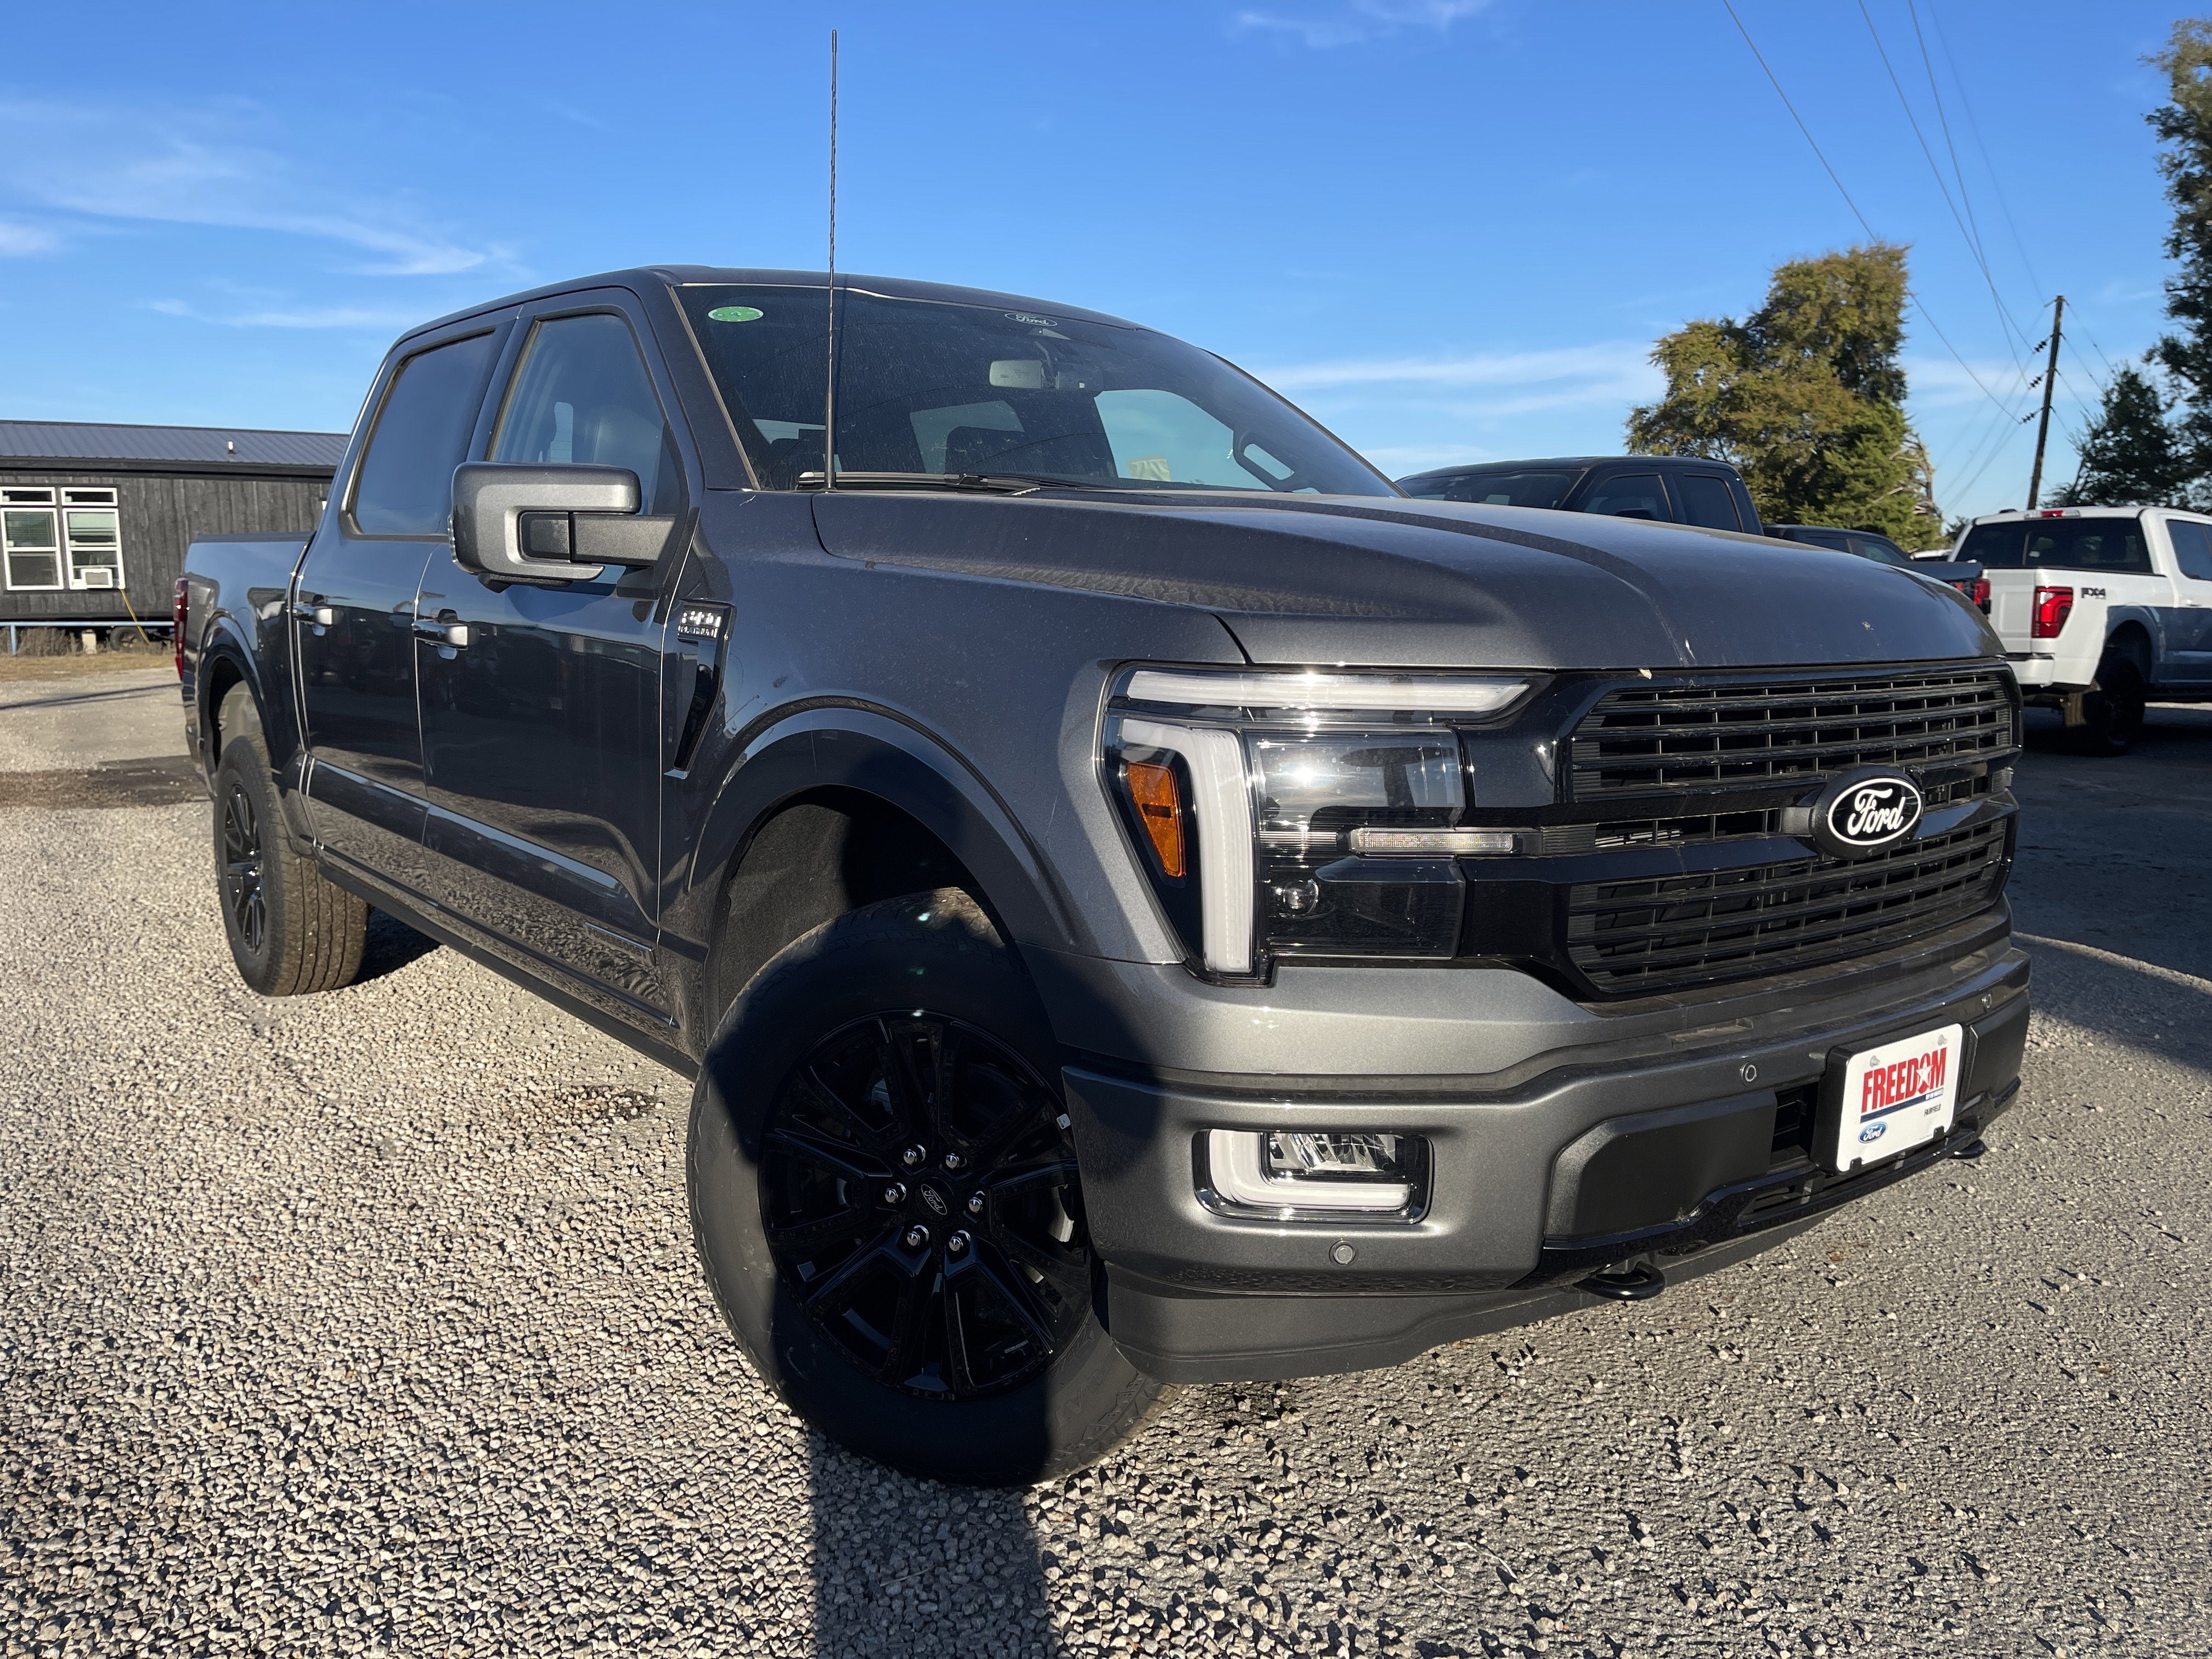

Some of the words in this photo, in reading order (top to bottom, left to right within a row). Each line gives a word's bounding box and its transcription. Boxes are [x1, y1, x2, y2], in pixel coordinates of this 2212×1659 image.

[2081, 588, 2106, 598] FX4
[1847, 788, 1906, 836] Ford
[1861, 1047, 1946, 1113] FREEDOM
[1863, 1125, 1883, 1141] Ford
[924, 1190, 943, 1210] Ford
